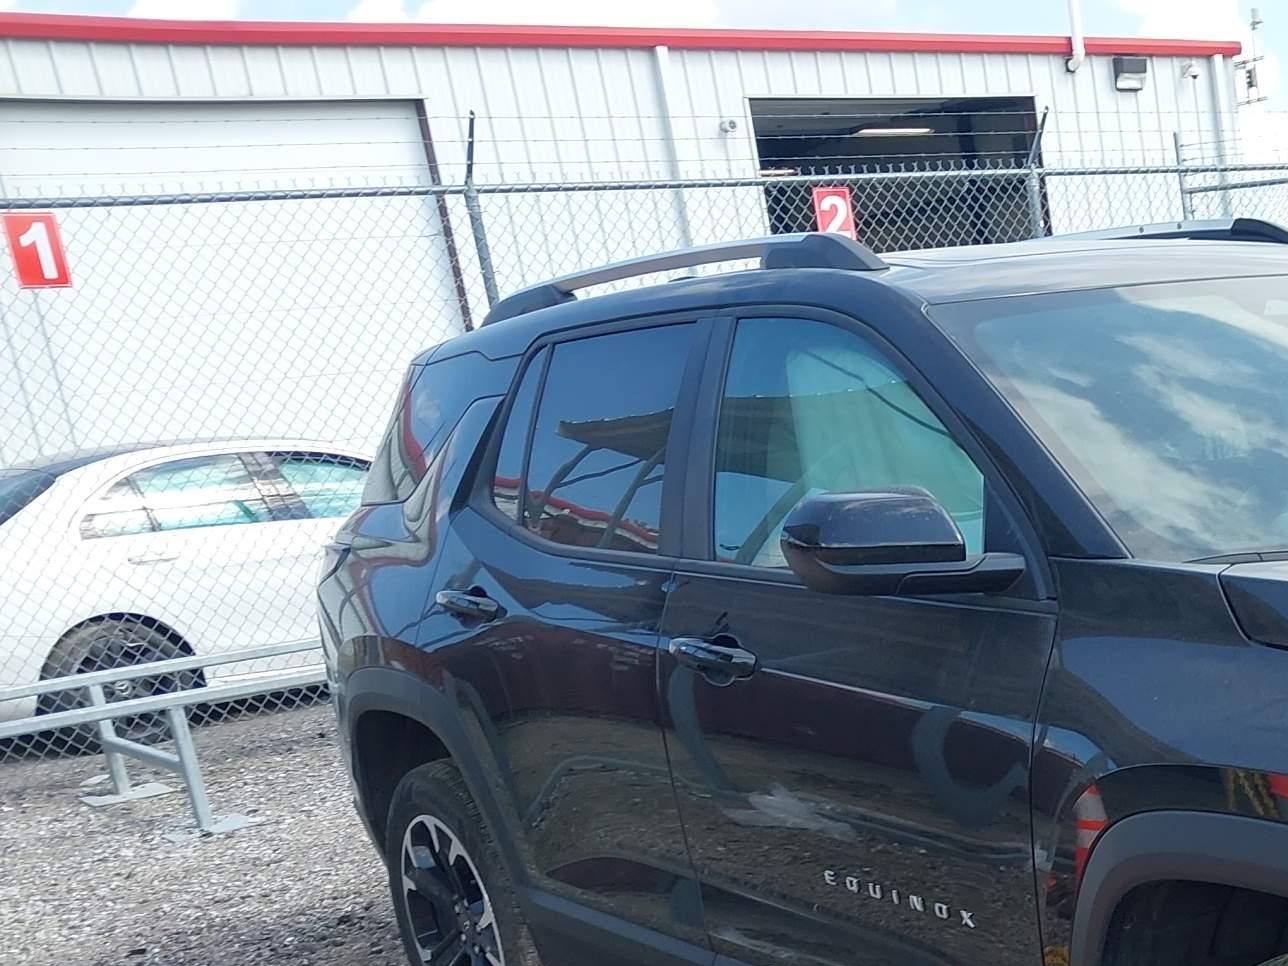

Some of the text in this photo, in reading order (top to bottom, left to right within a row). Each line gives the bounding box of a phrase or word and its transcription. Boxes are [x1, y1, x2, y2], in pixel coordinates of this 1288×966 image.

[820, 194, 852, 239] 2
[19, 221, 59, 280] 1
[822, 869, 978, 929] EQUINOX
